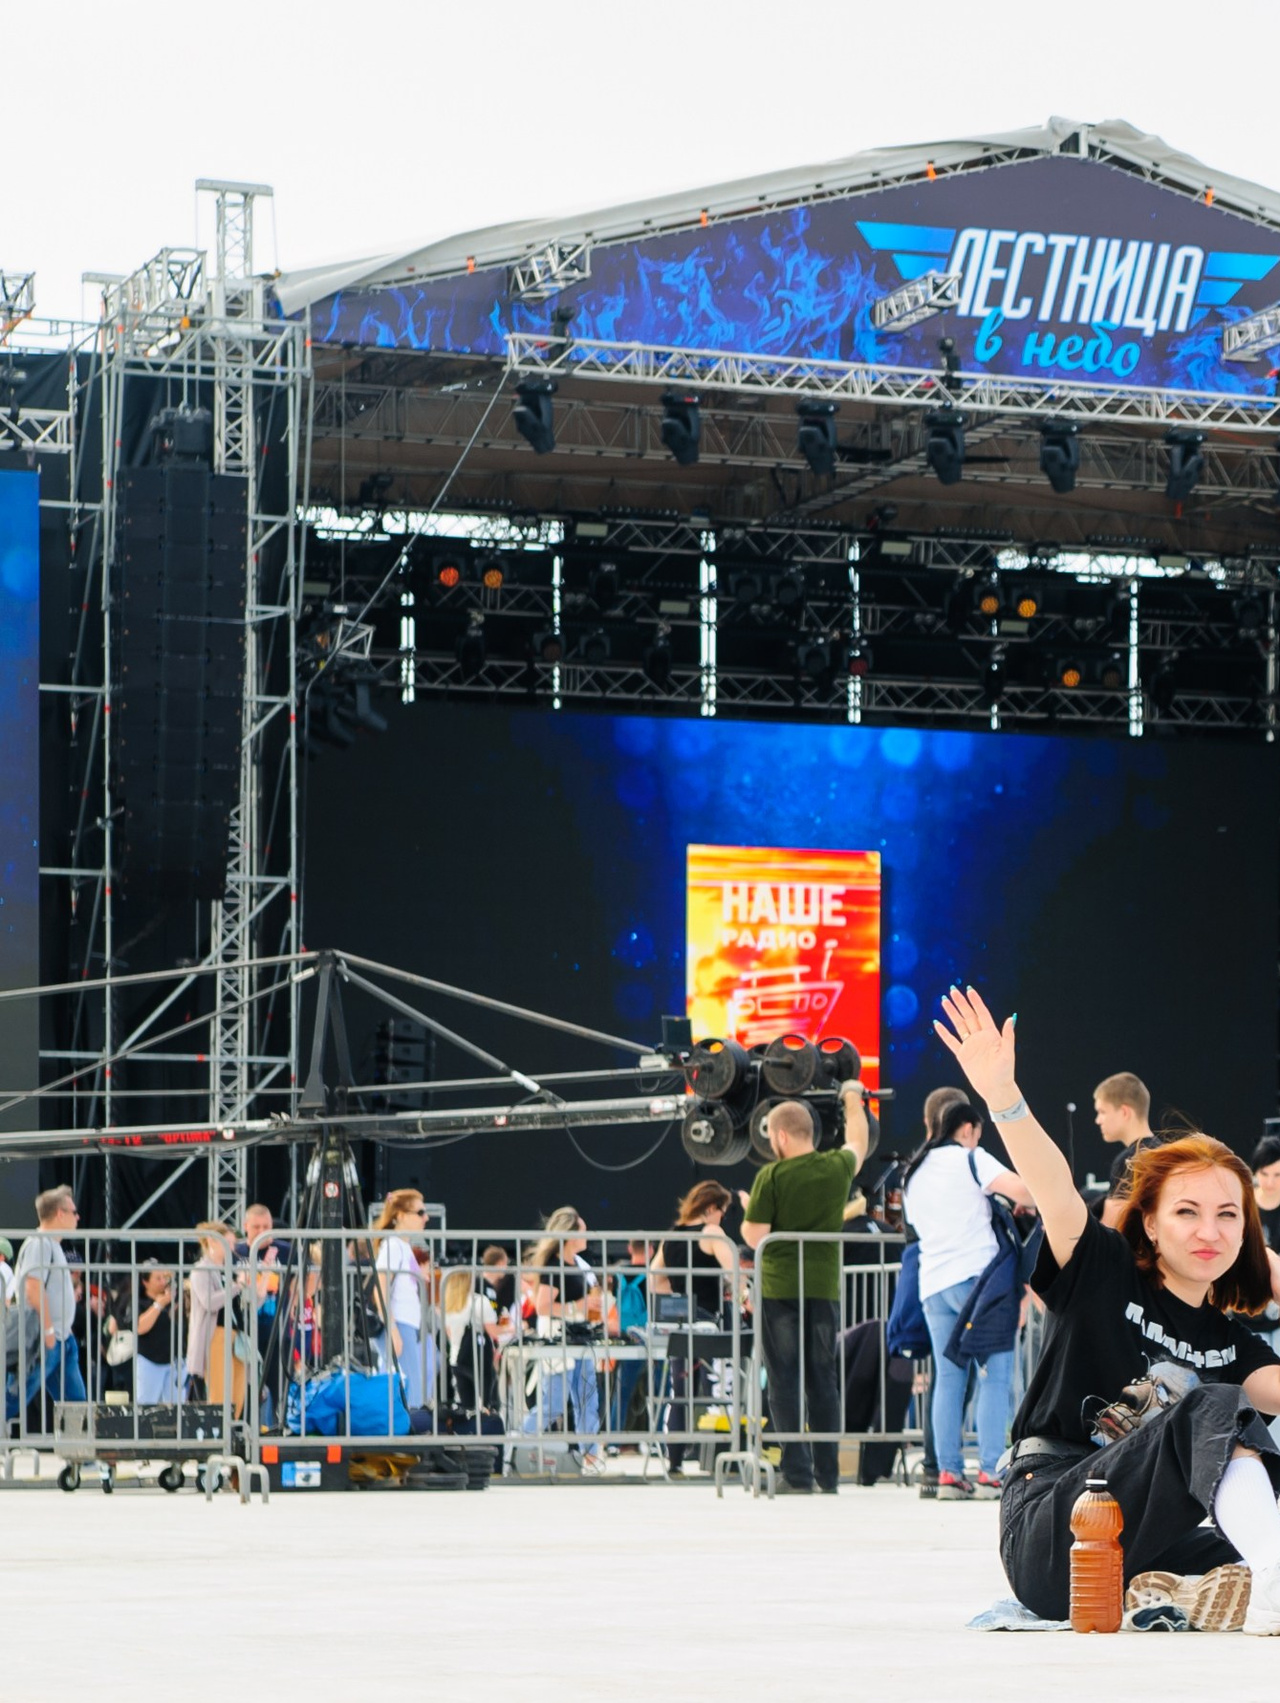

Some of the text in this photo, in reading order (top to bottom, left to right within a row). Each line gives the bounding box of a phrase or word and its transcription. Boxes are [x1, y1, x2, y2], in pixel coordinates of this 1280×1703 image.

[947, 226, 1206, 338] ЛЕСТНИЦА
[1021, 320, 1142, 378] небо
[721, 882, 848, 927] НАШЕ
[720, 929, 817, 951] РАДИО
